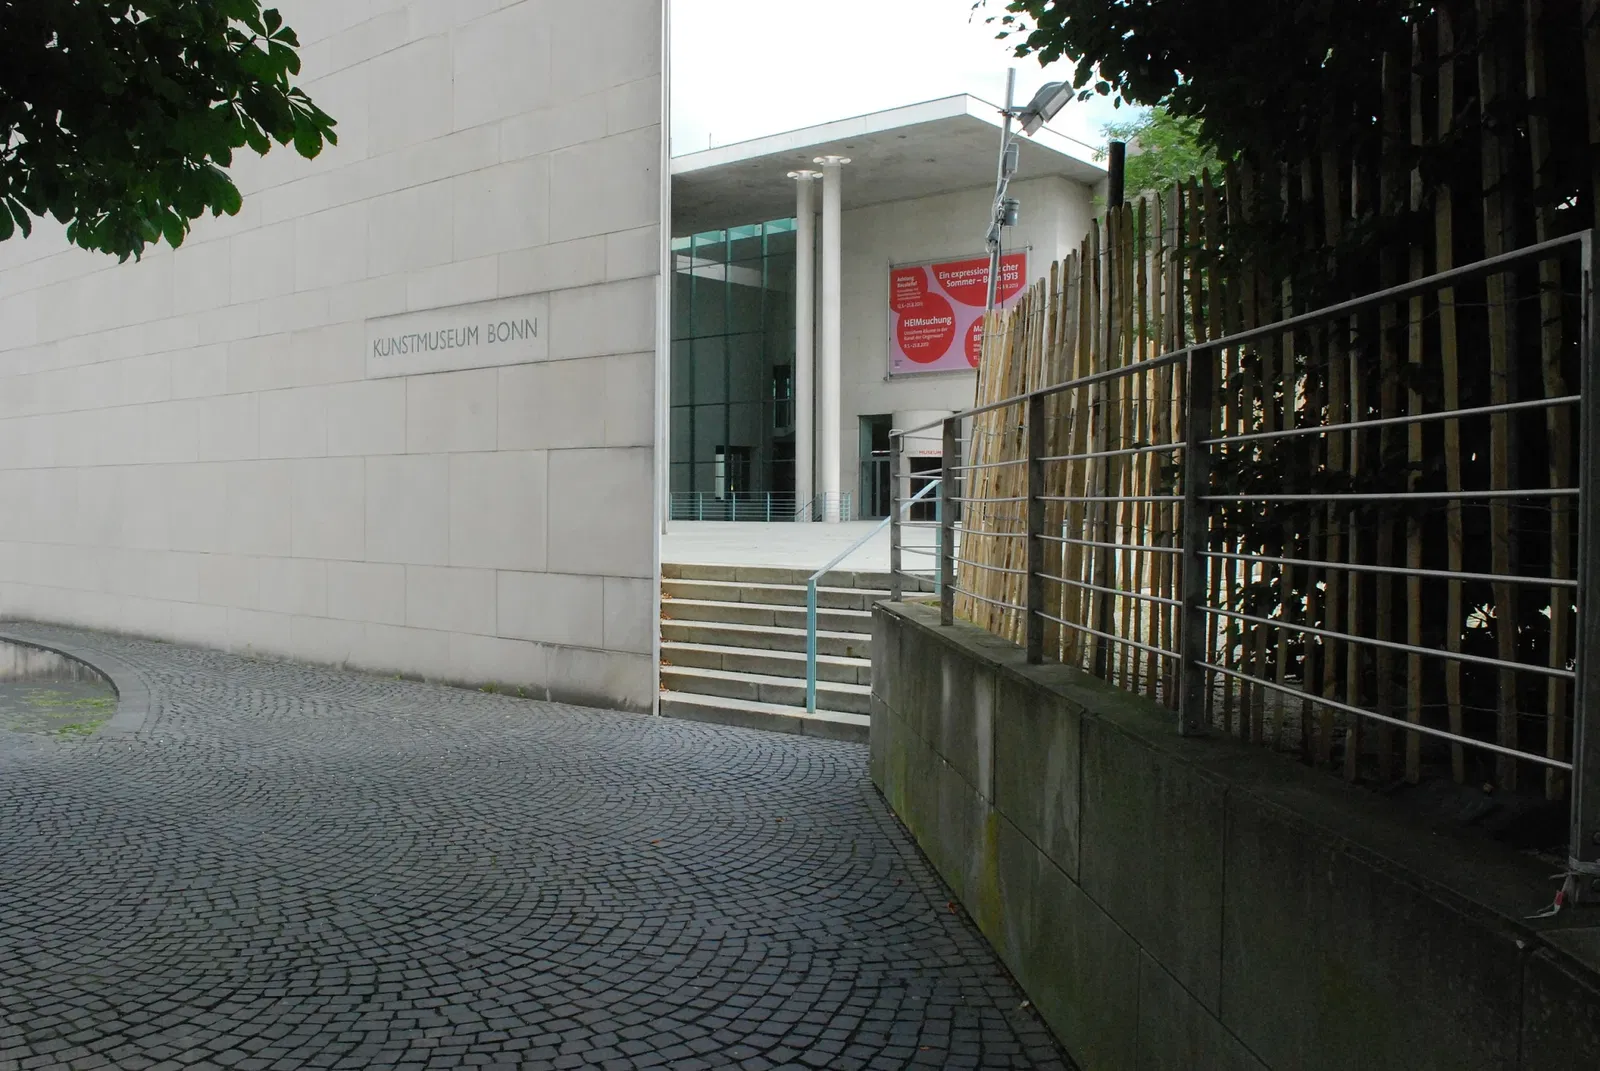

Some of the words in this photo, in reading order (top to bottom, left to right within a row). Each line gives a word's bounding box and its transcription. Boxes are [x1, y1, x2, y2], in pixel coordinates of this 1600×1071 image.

[939, 271, 950, 280] Ein
[951, 263, 1018, 279] expressionscher
[946, 278, 976, 288] Sommer
[983, 274, 1002, 284] Bn
[1003, 272, 1018, 280] 1913
[904, 316, 952, 327] HEIMsuchung
[374, 325, 479, 358] KUNSTMUSEUM
[488, 318, 538, 344] BONN
